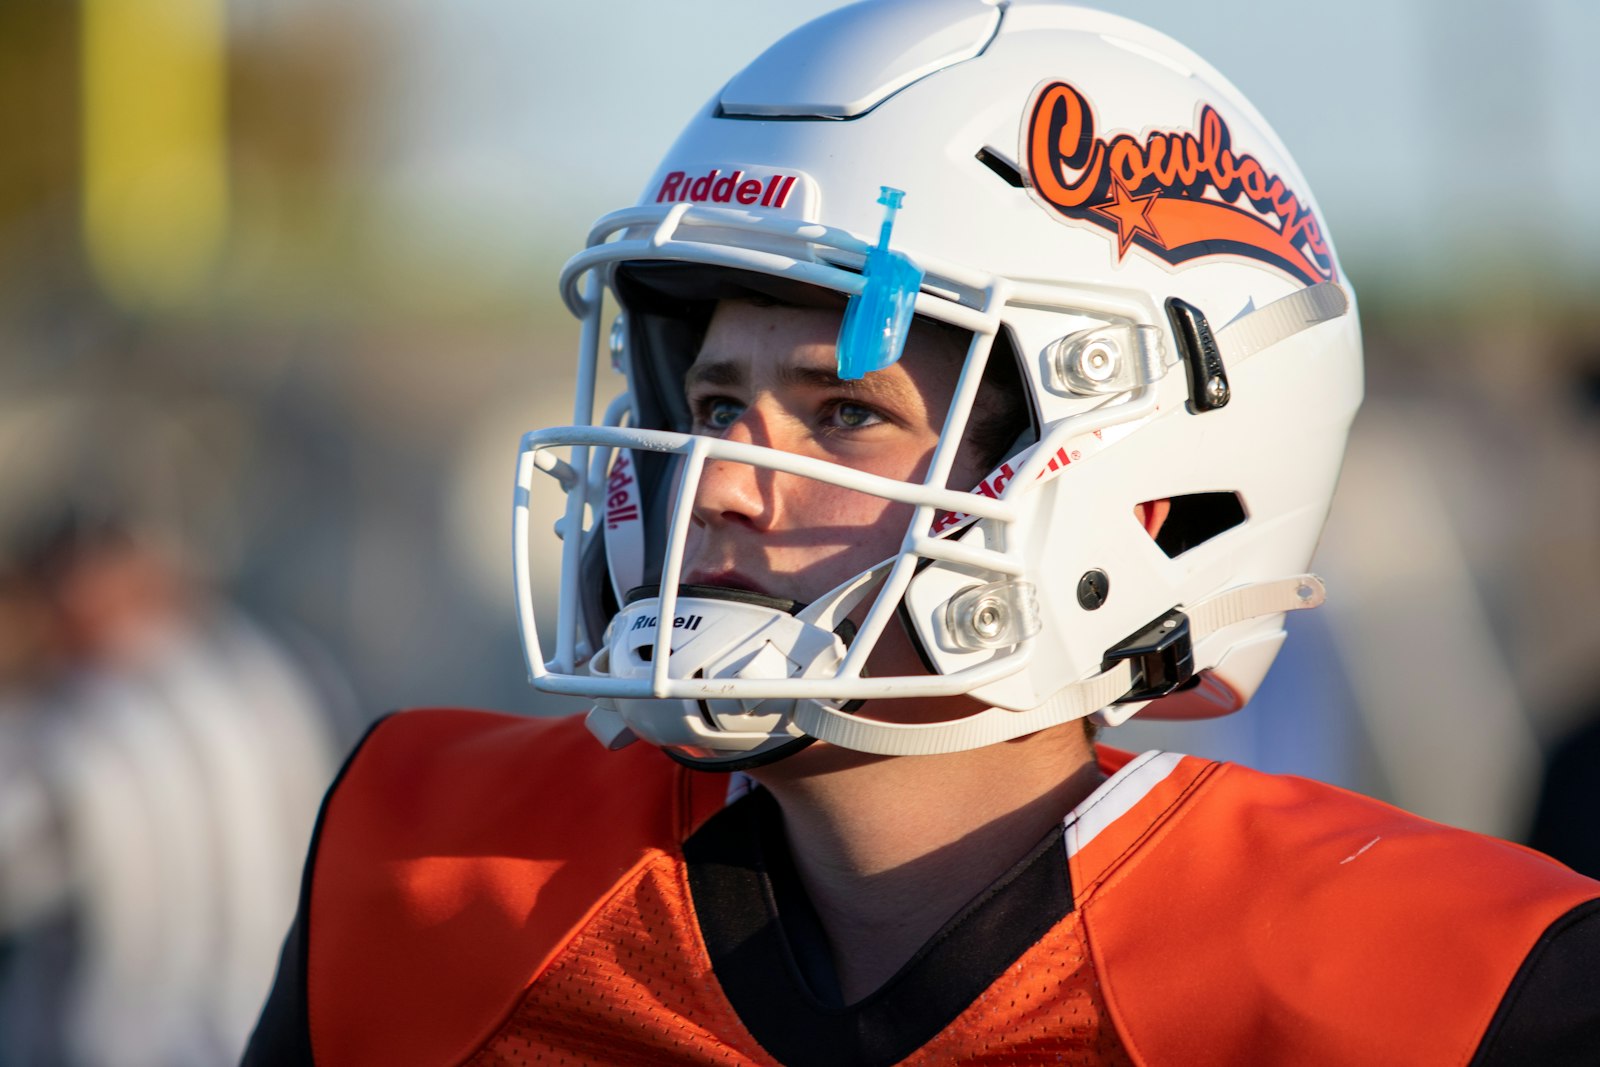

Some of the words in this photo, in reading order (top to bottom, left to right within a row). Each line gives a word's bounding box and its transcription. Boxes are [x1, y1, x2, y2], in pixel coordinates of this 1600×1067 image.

[656, 169, 799, 209] Riddell
[1027, 80, 1340, 285] Cowboys
[631, 614, 703, 631] Ridell
